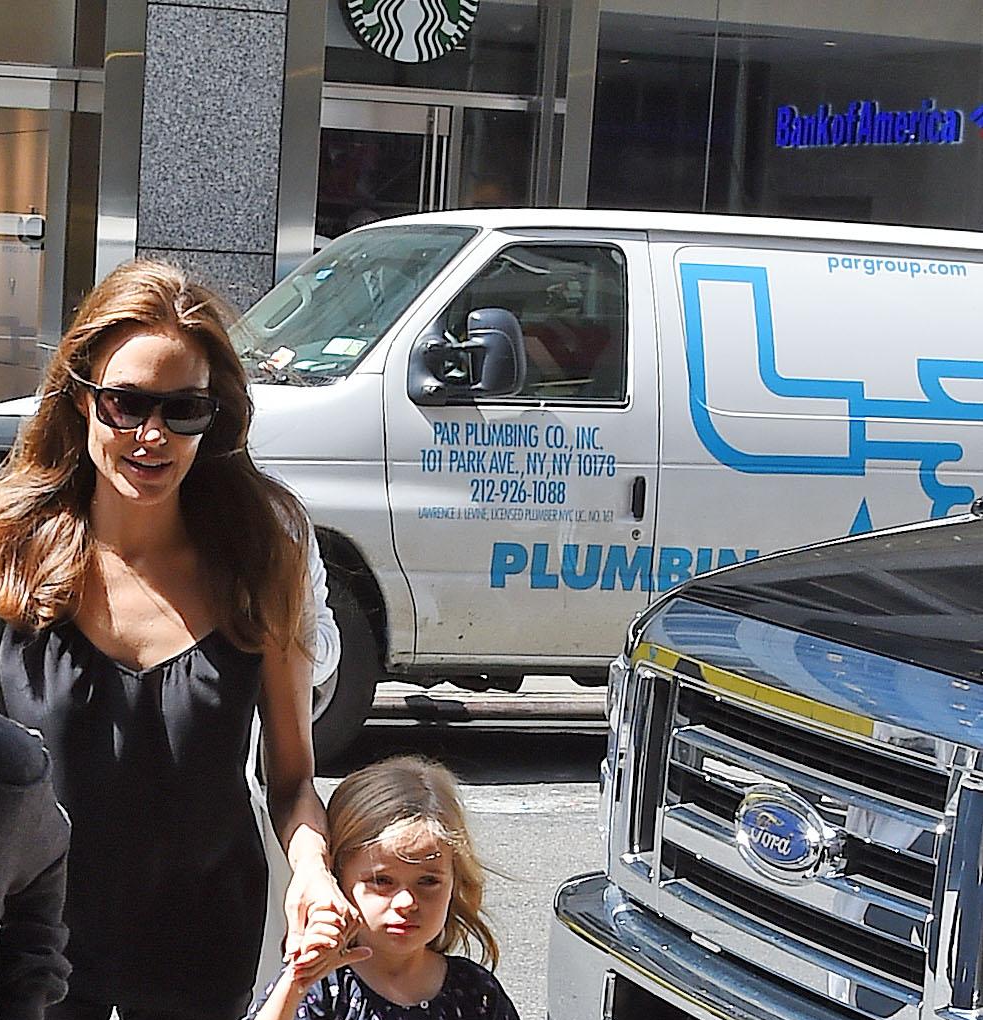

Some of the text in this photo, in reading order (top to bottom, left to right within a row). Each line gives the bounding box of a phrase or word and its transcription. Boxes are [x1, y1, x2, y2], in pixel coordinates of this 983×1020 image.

[827, 256, 967, 278] pargroup.com
[433, 422, 460, 446] PAR
[465, 423, 538, 447] PLUMBING
[576, 427, 604, 450] INC.
[420, 450, 442, 472] 101
[449, 450, 485, 474] PARK
[577, 454, 616, 477] 10178
[470, 479, 566, 504] 212-926-1088
[750, 811, 792, 856] Ford
